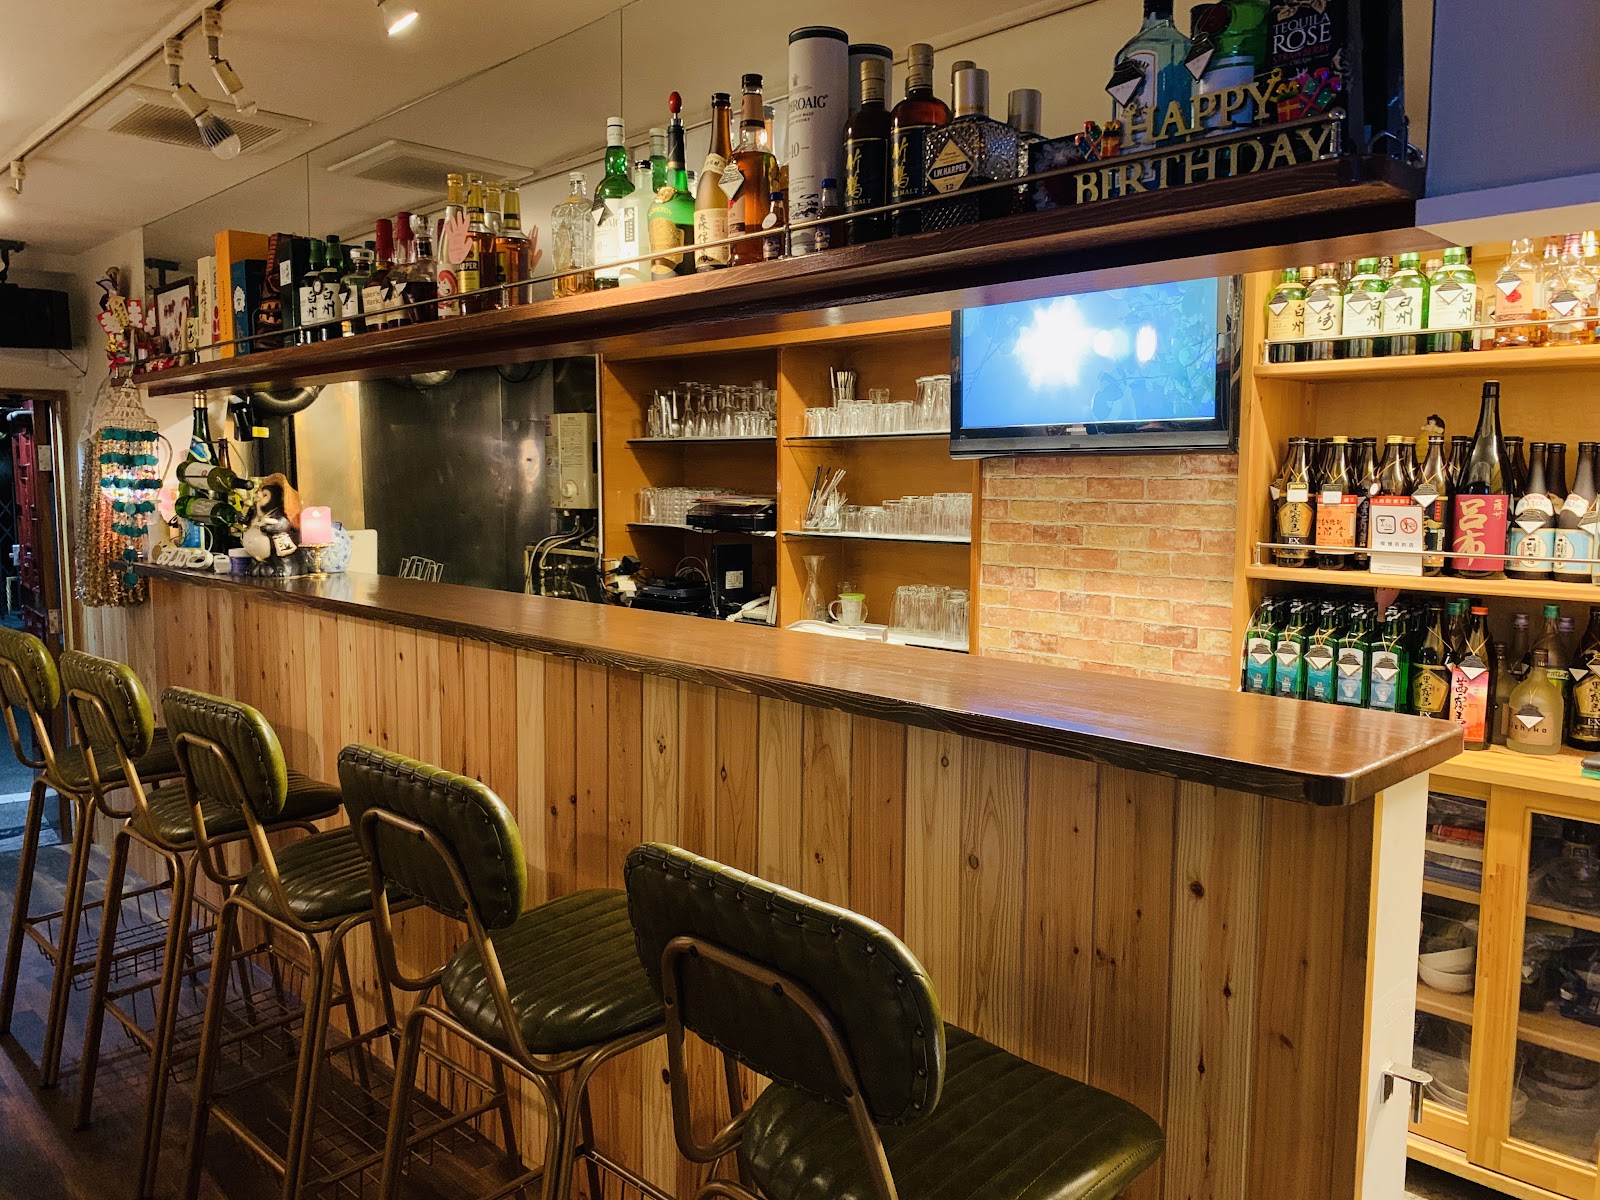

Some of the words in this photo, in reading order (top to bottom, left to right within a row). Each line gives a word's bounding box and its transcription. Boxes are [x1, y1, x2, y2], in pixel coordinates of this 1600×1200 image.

[1272, 12, 1331, 35] TEQUILA
[1272, 22, 1332, 54] ROSE
[1120, 79, 1277, 150] HAPPY
[933, 163, 967, 178] I.W.HARPER
[1073, 125, 1332, 205] BIRTHDAY
[946, 183, 954, 191] 12
[307, 291, 317, 318] 白州
[322, 288, 336, 318] 白州
[1317, 303, 1336, 331] 山崎
[1366, 297, 1382, 330] 白州
[1396, 296, 1413, 327] 白州
[1458, 288, 1473, 323] 白州
[1291, 304, 1305, 333] 白州
[1452, 498, 1488, 567] 呂布
